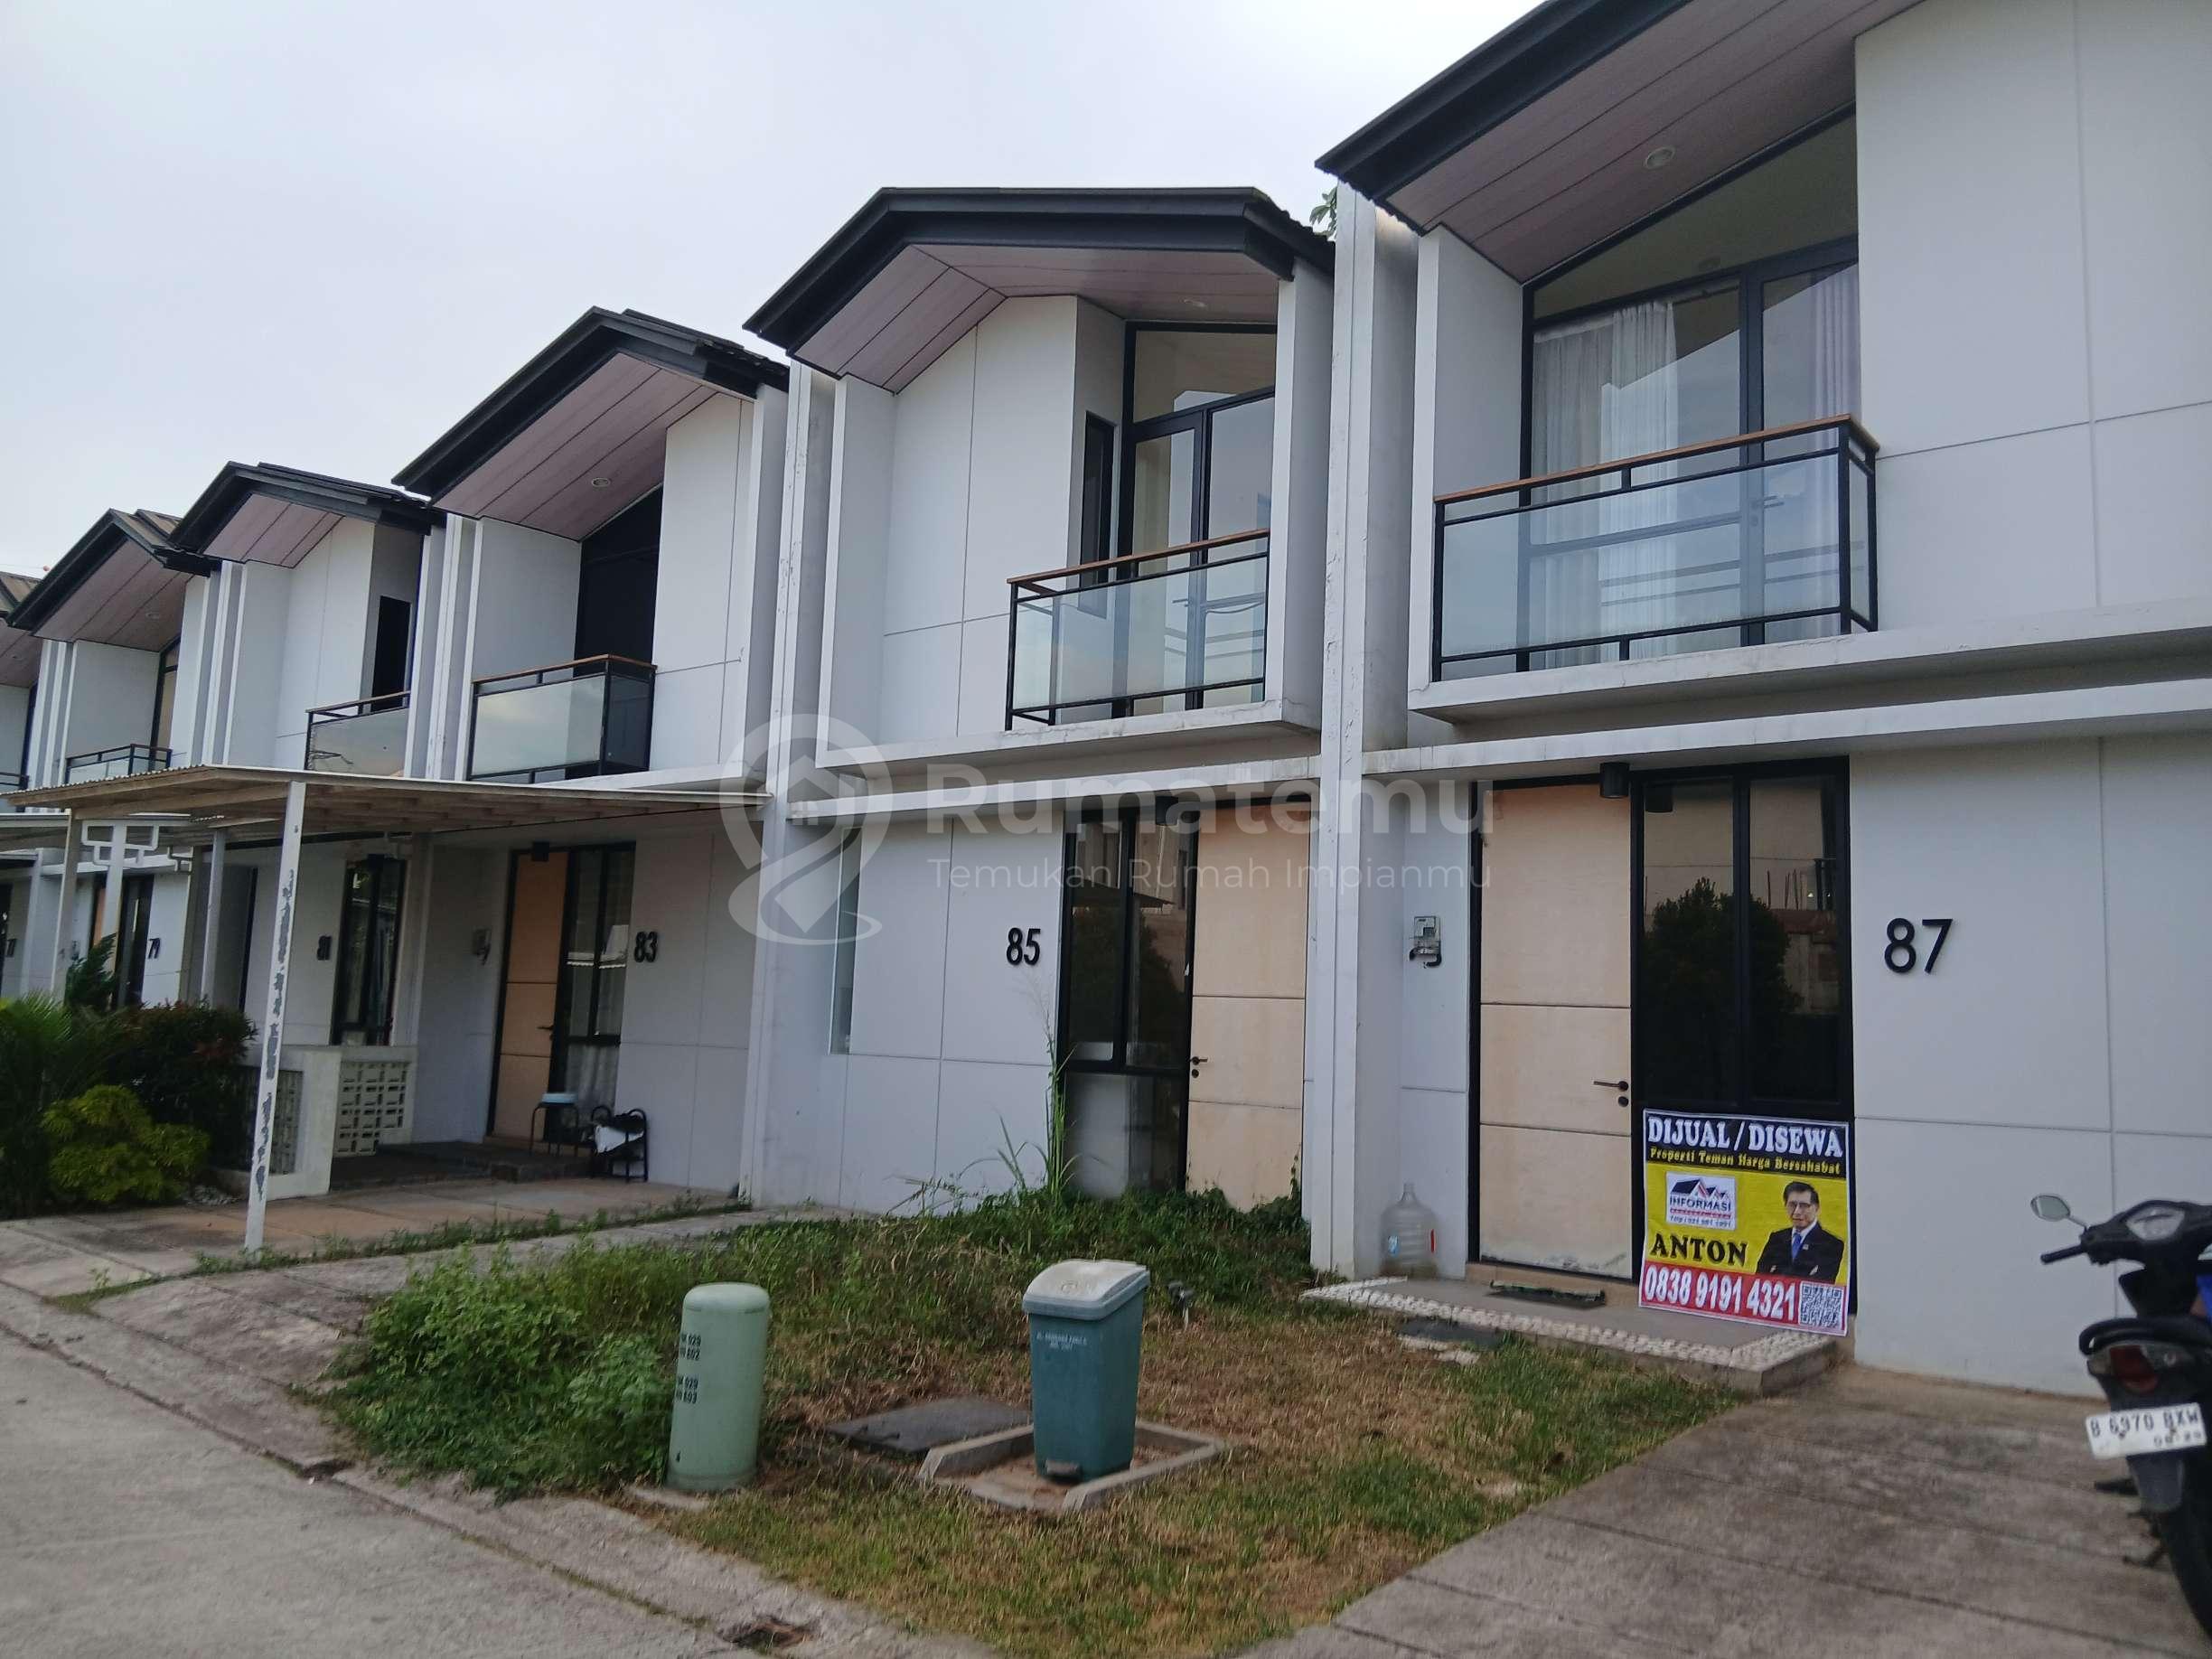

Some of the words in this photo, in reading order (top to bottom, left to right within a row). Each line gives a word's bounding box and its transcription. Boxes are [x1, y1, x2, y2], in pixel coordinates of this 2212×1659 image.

[148, 937, 161, 960] 79
[316, 935, 332, 961] 81
[634, 931, 658, 963] 83
[1006, 927, 1041, 966] 85
[1884, 917, 1954, 974] 87
[1647, 1116, 1730, 1149] DIJUAL
[1734, 1121, 1745, 1151] /
[1748, 1122, 1843, 1158] DISEWA
[1650, 1146, 1694, 1162] Properti
[1699, 1150, 1734, 1166] Teman
[1739, 1153, 1770, 1170] Harga
[1775, 1157, 1841, 1175] Bersahabat
[1670, 1195, 1731, 1212] INFORMASI
[1650, 1233, 1748, 1267] ANTON
[1645, 1264, 1692, 1306] 0838
[1695, 1272, 1743, 1313] 9191
[1747, 1279, 1795, 1323] 4321
[2090, 1417, 2102, 1439] B
